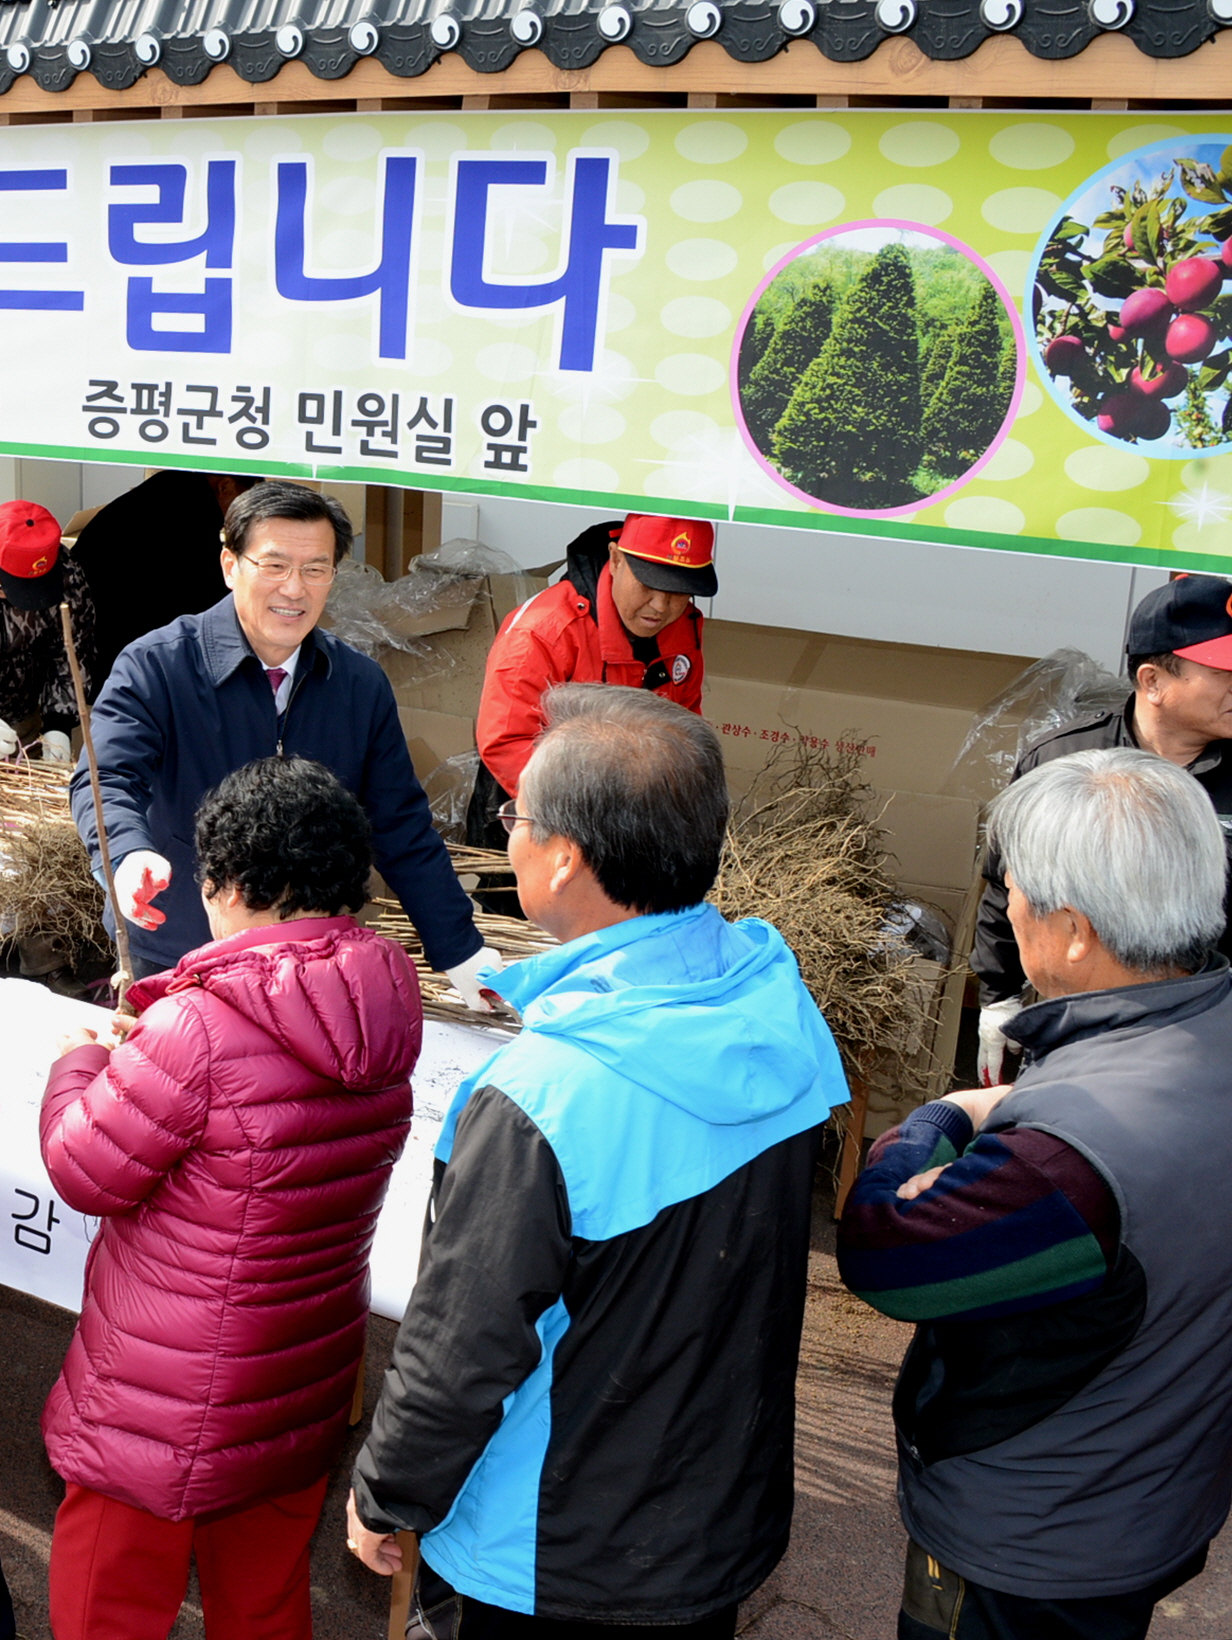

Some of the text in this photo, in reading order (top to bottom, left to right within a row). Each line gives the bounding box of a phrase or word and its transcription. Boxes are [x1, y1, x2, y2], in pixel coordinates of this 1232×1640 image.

[82, 379, 537, 472] 증평군청 민원실 앞
[11, 1188, 60, 1255] 감
